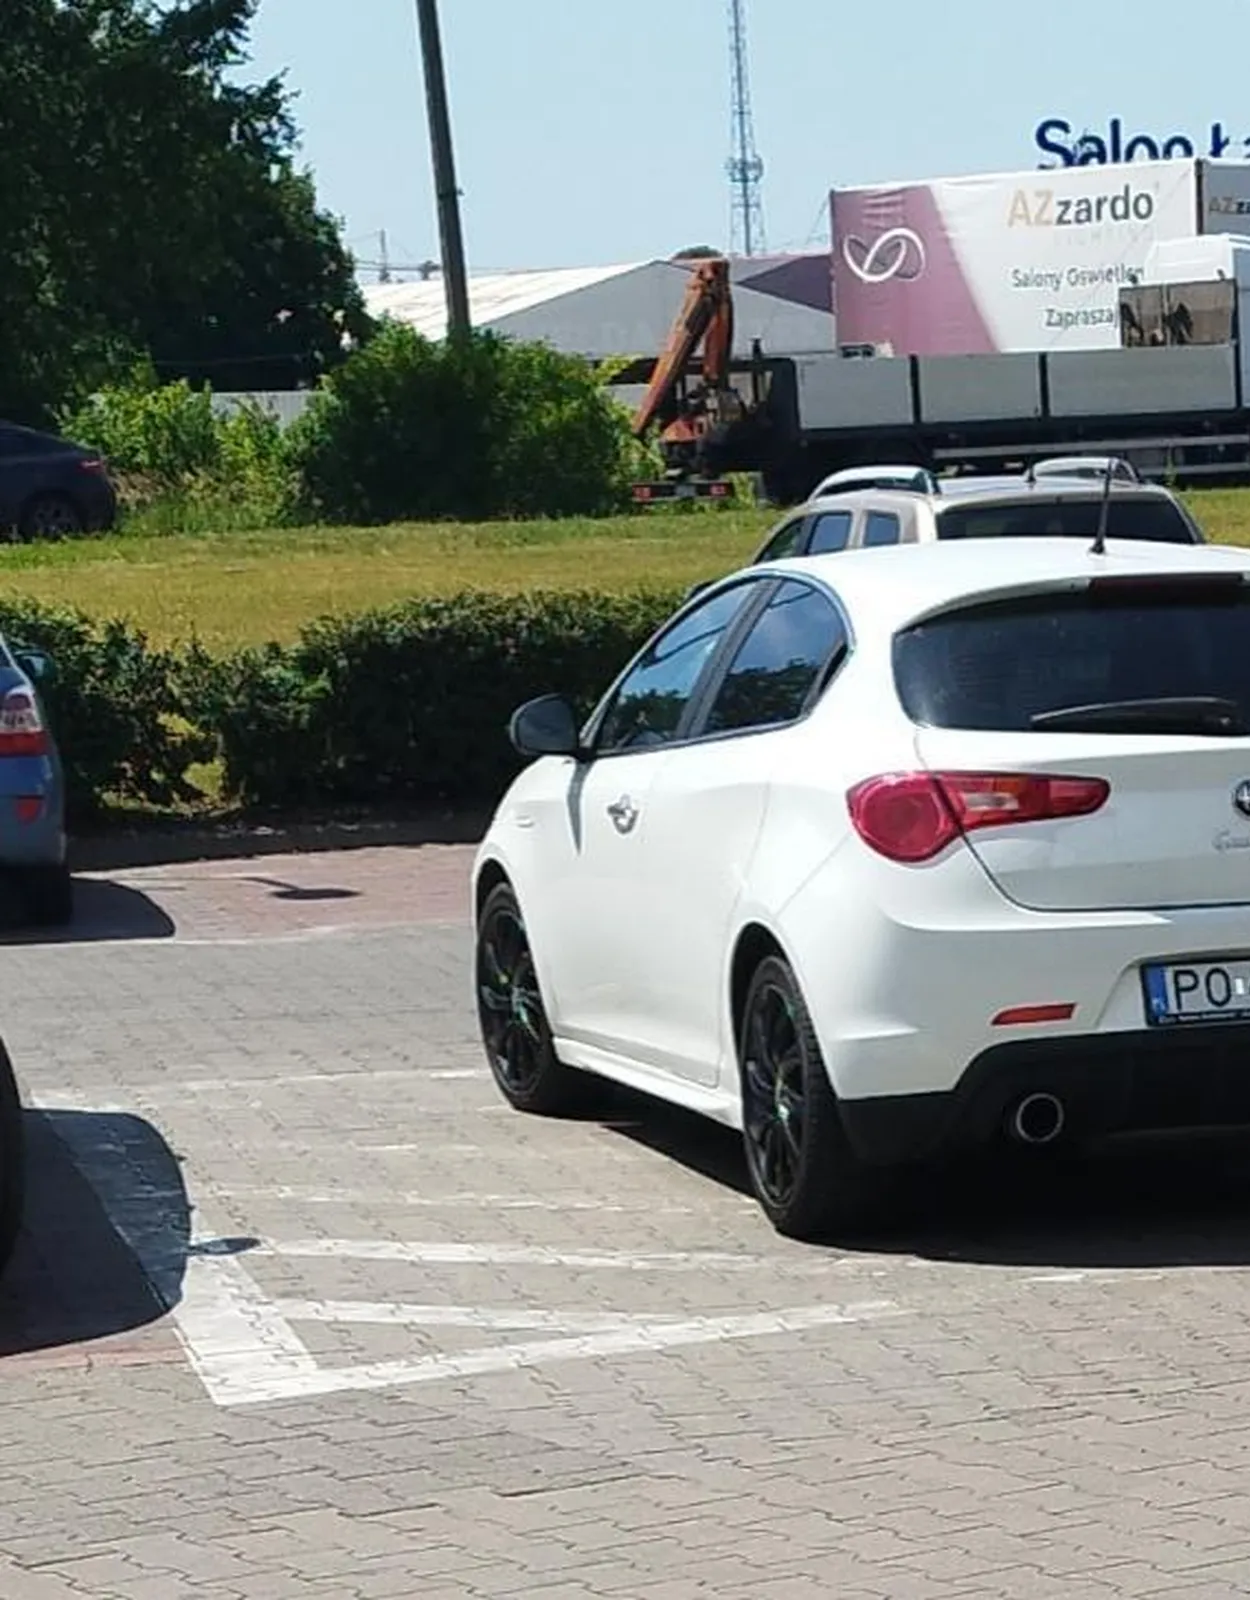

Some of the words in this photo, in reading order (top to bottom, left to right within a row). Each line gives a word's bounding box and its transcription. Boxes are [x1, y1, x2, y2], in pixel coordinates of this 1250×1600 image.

[1035, 118, 1194, 169] Salon
[1008, 184, 1154, 227] AZzardo
[1012, 267, 1062, 291] Salony
[1173, 966, 1232, 1010] PO
